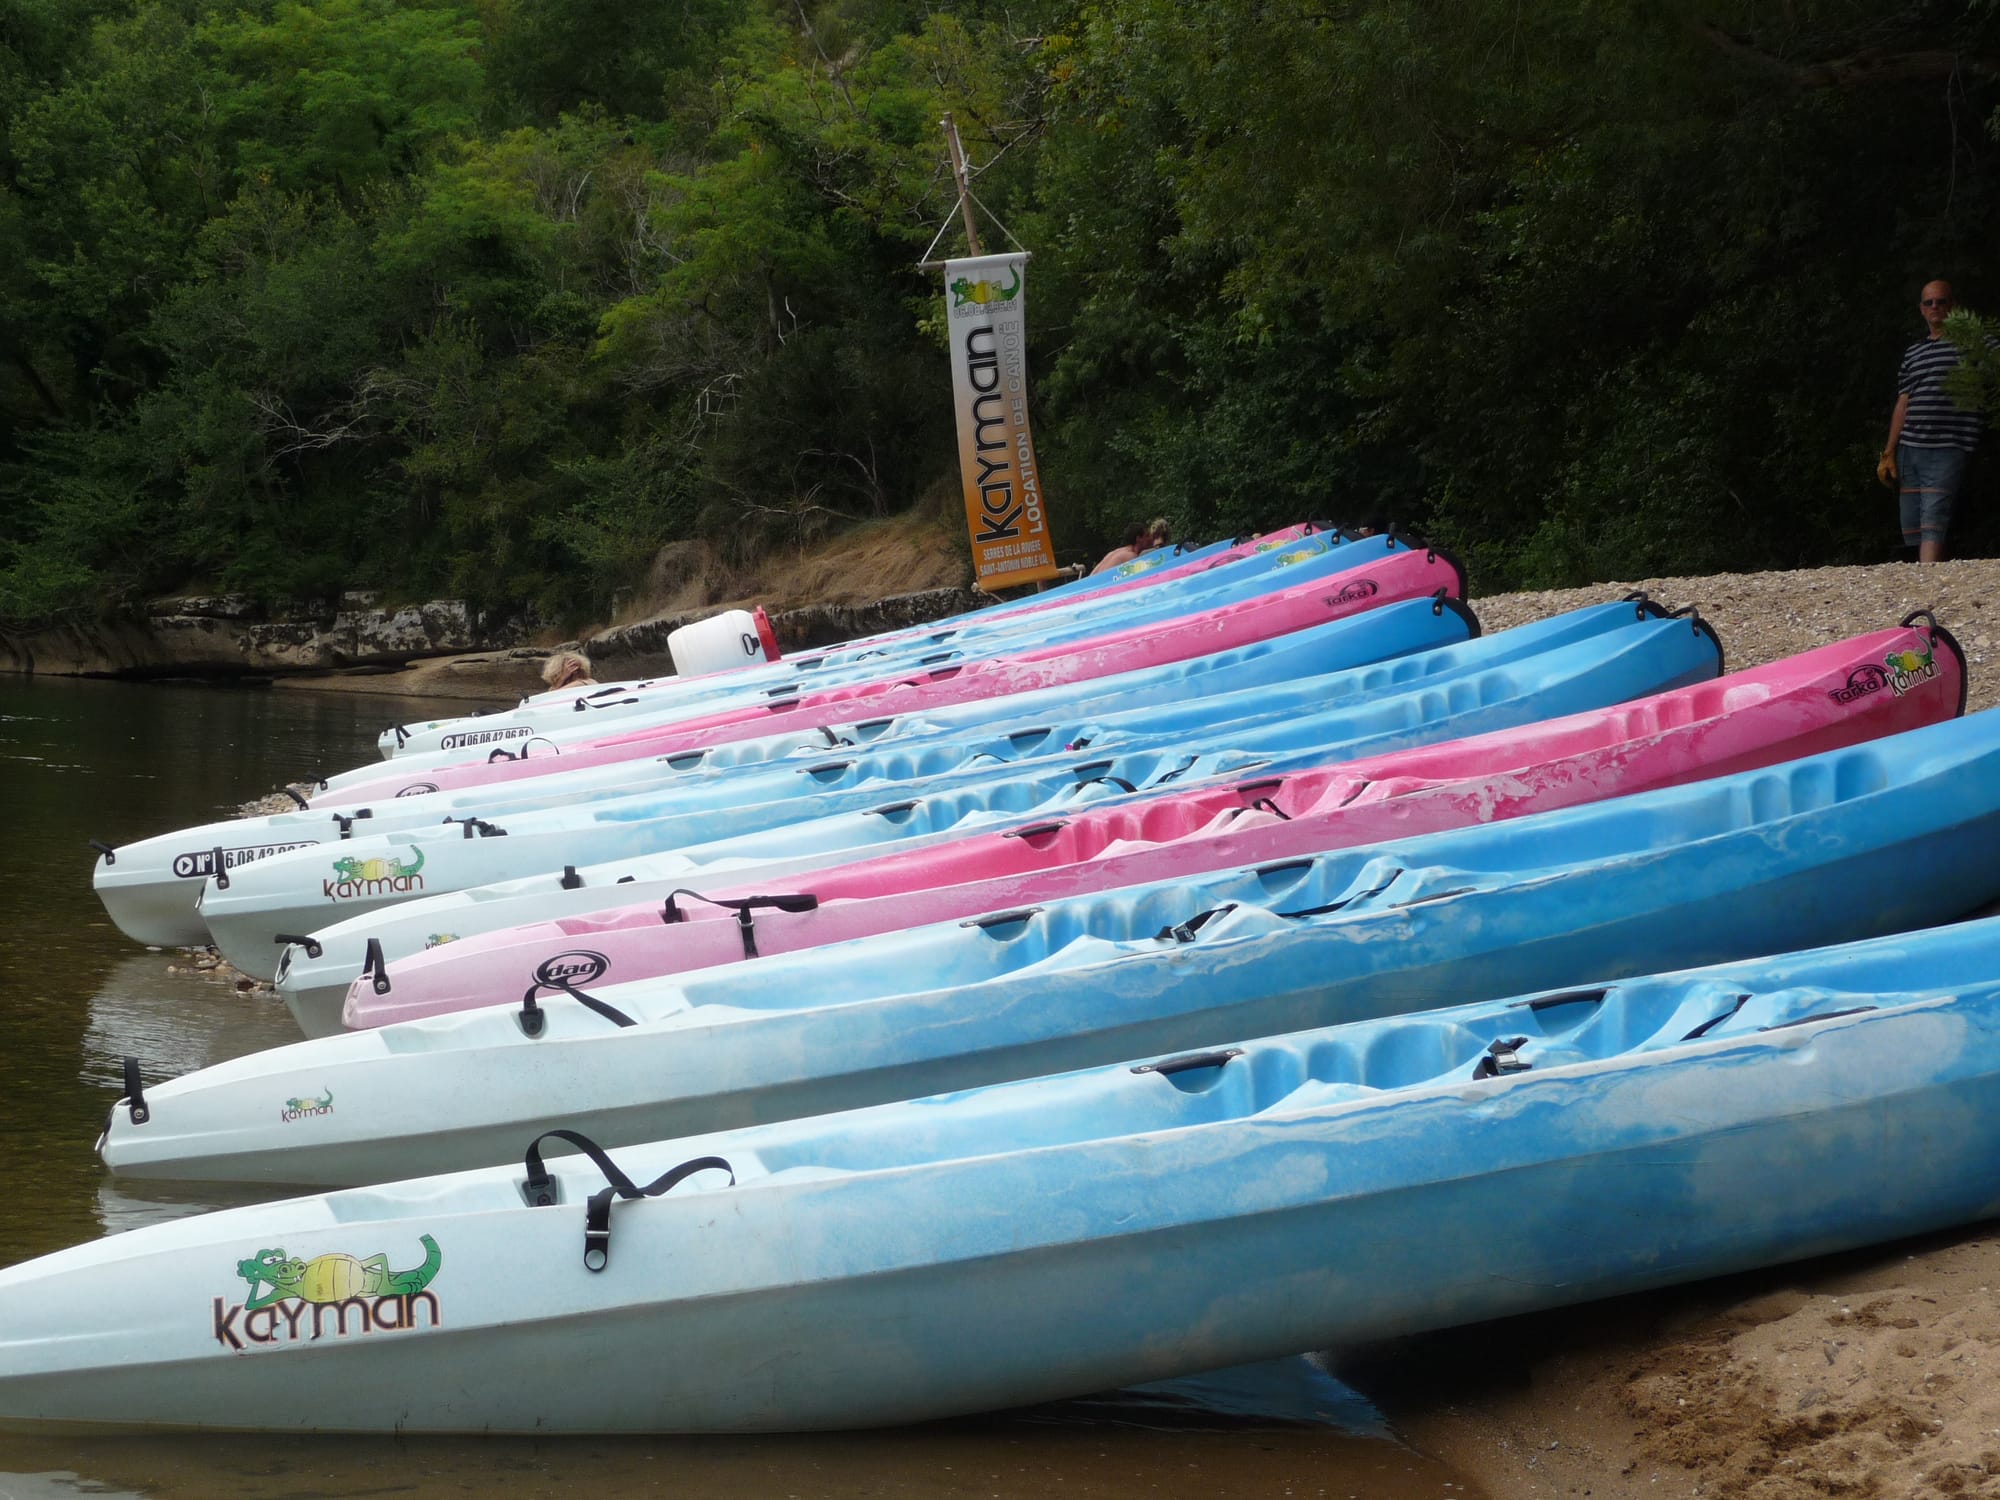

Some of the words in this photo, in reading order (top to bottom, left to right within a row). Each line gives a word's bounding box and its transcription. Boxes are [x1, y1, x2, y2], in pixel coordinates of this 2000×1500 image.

[1012, 397, 1025, 426] DE
[966, 325, 1024, 543] kayman
[1016, 431, 1043, 534] LOCATION
[1828, 677, 1879, 704] Tarka
[1885, 659, 1942, 697] kayman
[323, 873, 424, 902] kayman
[546, 961, 597, 977] dag
[281, 1104, 334, 1123] kayman
[212, 1289, 441, 1351] kayman
